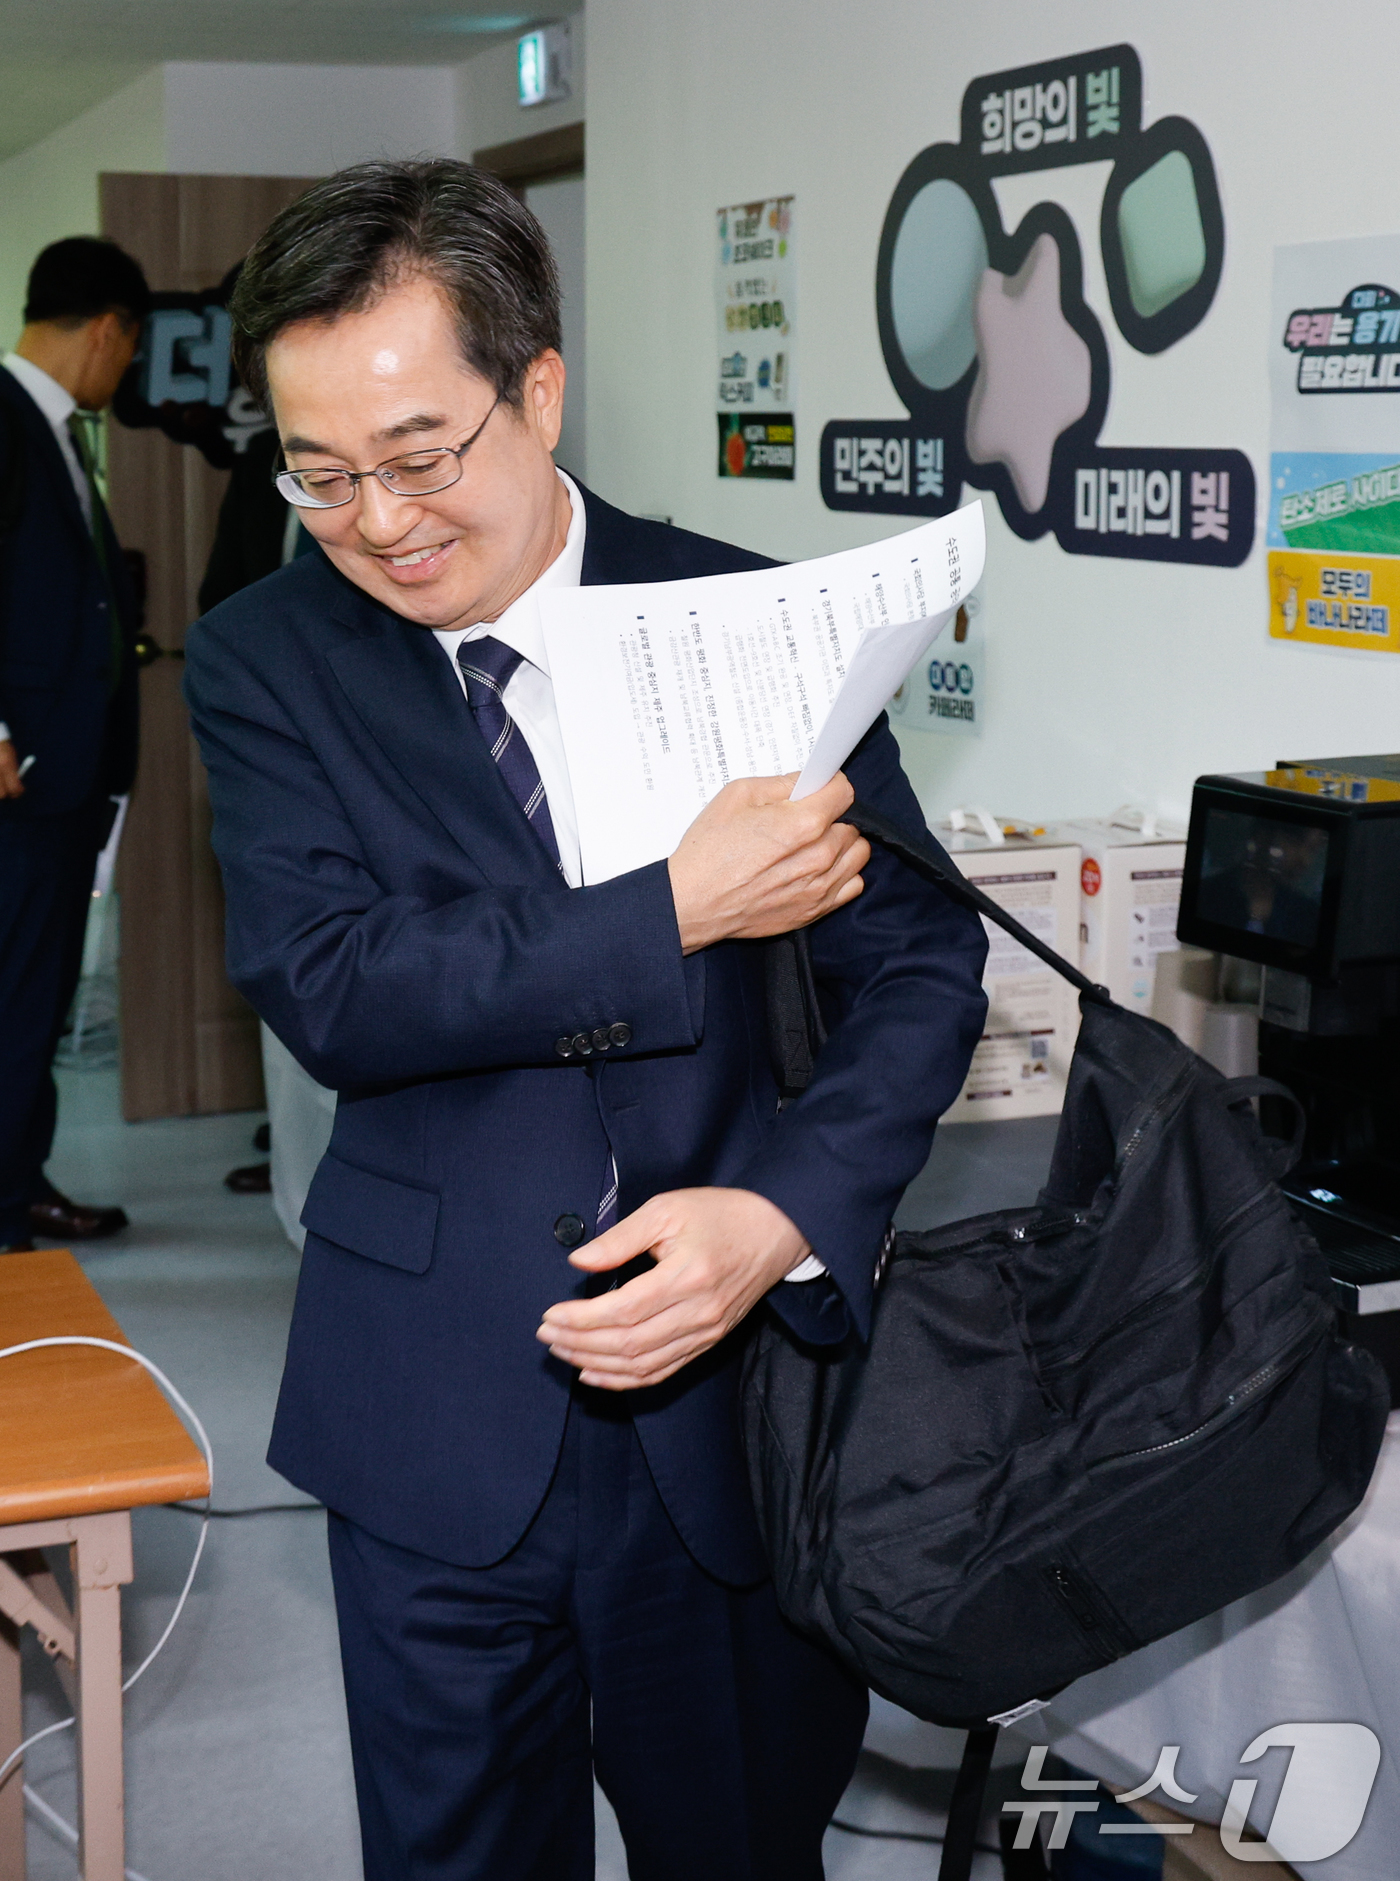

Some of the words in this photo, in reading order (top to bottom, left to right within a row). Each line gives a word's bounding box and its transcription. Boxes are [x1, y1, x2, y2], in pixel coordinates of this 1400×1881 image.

[981, 75, 1078, 155] 희망의
[1085, 66, 1120, 138] 빛
[1286, 312, 1354, 347] 우리는
[834, 437, 910, 496] 민주의
[916, 438, 944, 498] 빛
[1075, 469, 1181, 538] 미래의
[1190, 471, 1230, 542] 빛
[1281, 482, 1347, 526] 탄소제로
[946, 538, 960, 566] 수도권
[913, 568, 924, 599] 국회의사당
[950, 567, 961, 586] 공통
[1321, 569, 1371, 599] 모두의
[874, 584, 888, 616] 해양수산부
[904, 583, 913, 608] 국회의사당
[865, 598, 875, 624] 해양수산부
[691, 623, 702, 645] 한반도
[812, 614, 821, 632] 북부권
[629, 640, 638, 658] 관광청
[638, 627, 650, 650] 글로벌
[681, 635, 689, 647] 철원
[735, 635, 745, 652] 급행화
[816, 634, 826, 657] 공공기관
[822, 600, 842, 662] 경기북부특별자치도
[836, 664, 845, 678] 설치
[634, 661, 642, 672] 신설
[644, 653, 654, 668] 관광
[696, 648, 706, 664] 평화
[722, 631, 737, 679] 경기남부광역철도
[732, 682, 740, 694] 신설
[757, 625, 767, 649] 도시철도
[762, 651, 771, 663] 연장
[767, 675, 777, 692] 급행화
[772, 696, 780, 707] 추진
[776, 654, 784, 665] 조기
[780, 610, 792, 631] 수도권
[786, 635, 799, 663] 교통혁신
[794, 673, 808, 701] 구석구석
[684, 650, 697, 686] 평화산업단지
[739, 656, 753, 691] 전면도입으로
[778, 668, 787, 679] 완공
[821, 659, 831, 676] 이전과
[639, 685, 647, 697] 제주
[647, 672, 659, 693] 중심지
[642, 700, 650, 712] 유치
[653, 698, 663, 712] 제주
[692, 689, 702, 713] 조성으로
[705, 695, 717, 717] 진정한
[748, 694, 758, 718] 이동시간
[632, 708, 641, 720] 도입
[645, 715, 653, 727] 추진
[669, 636, 680, 666] 금강산관광
[676, 670, 684, 681] 재개
[680, 693, 694, 730] 남북교류협력
[688, 733, 696, 745] 확대
[692, 757, 703, 782] 남북관계
[698, 785, 706, 798] 개선
[756, 679, 767, 702] 신분당선
[762, 705, 770, 717] 연장
[769, 738, 780, 762] 인천지역
[656, 716, 671, 754] 업그레이드
[697, 717, 708, 741] 남북경협
[754, 720, 762, 732] 대폭
[791, 722, 801, 745] 차질없이
[637, 732, 645, 744] 관광
[756, 735, 765, 748] 단축
[640, 747, 648, 759] 수익
[702, 744, 713, 769] 관문으로
[643, 762, 651, 774] 도민
[708, 772, 716, 784] 추진
[645, 778, 654, 790] 환원
